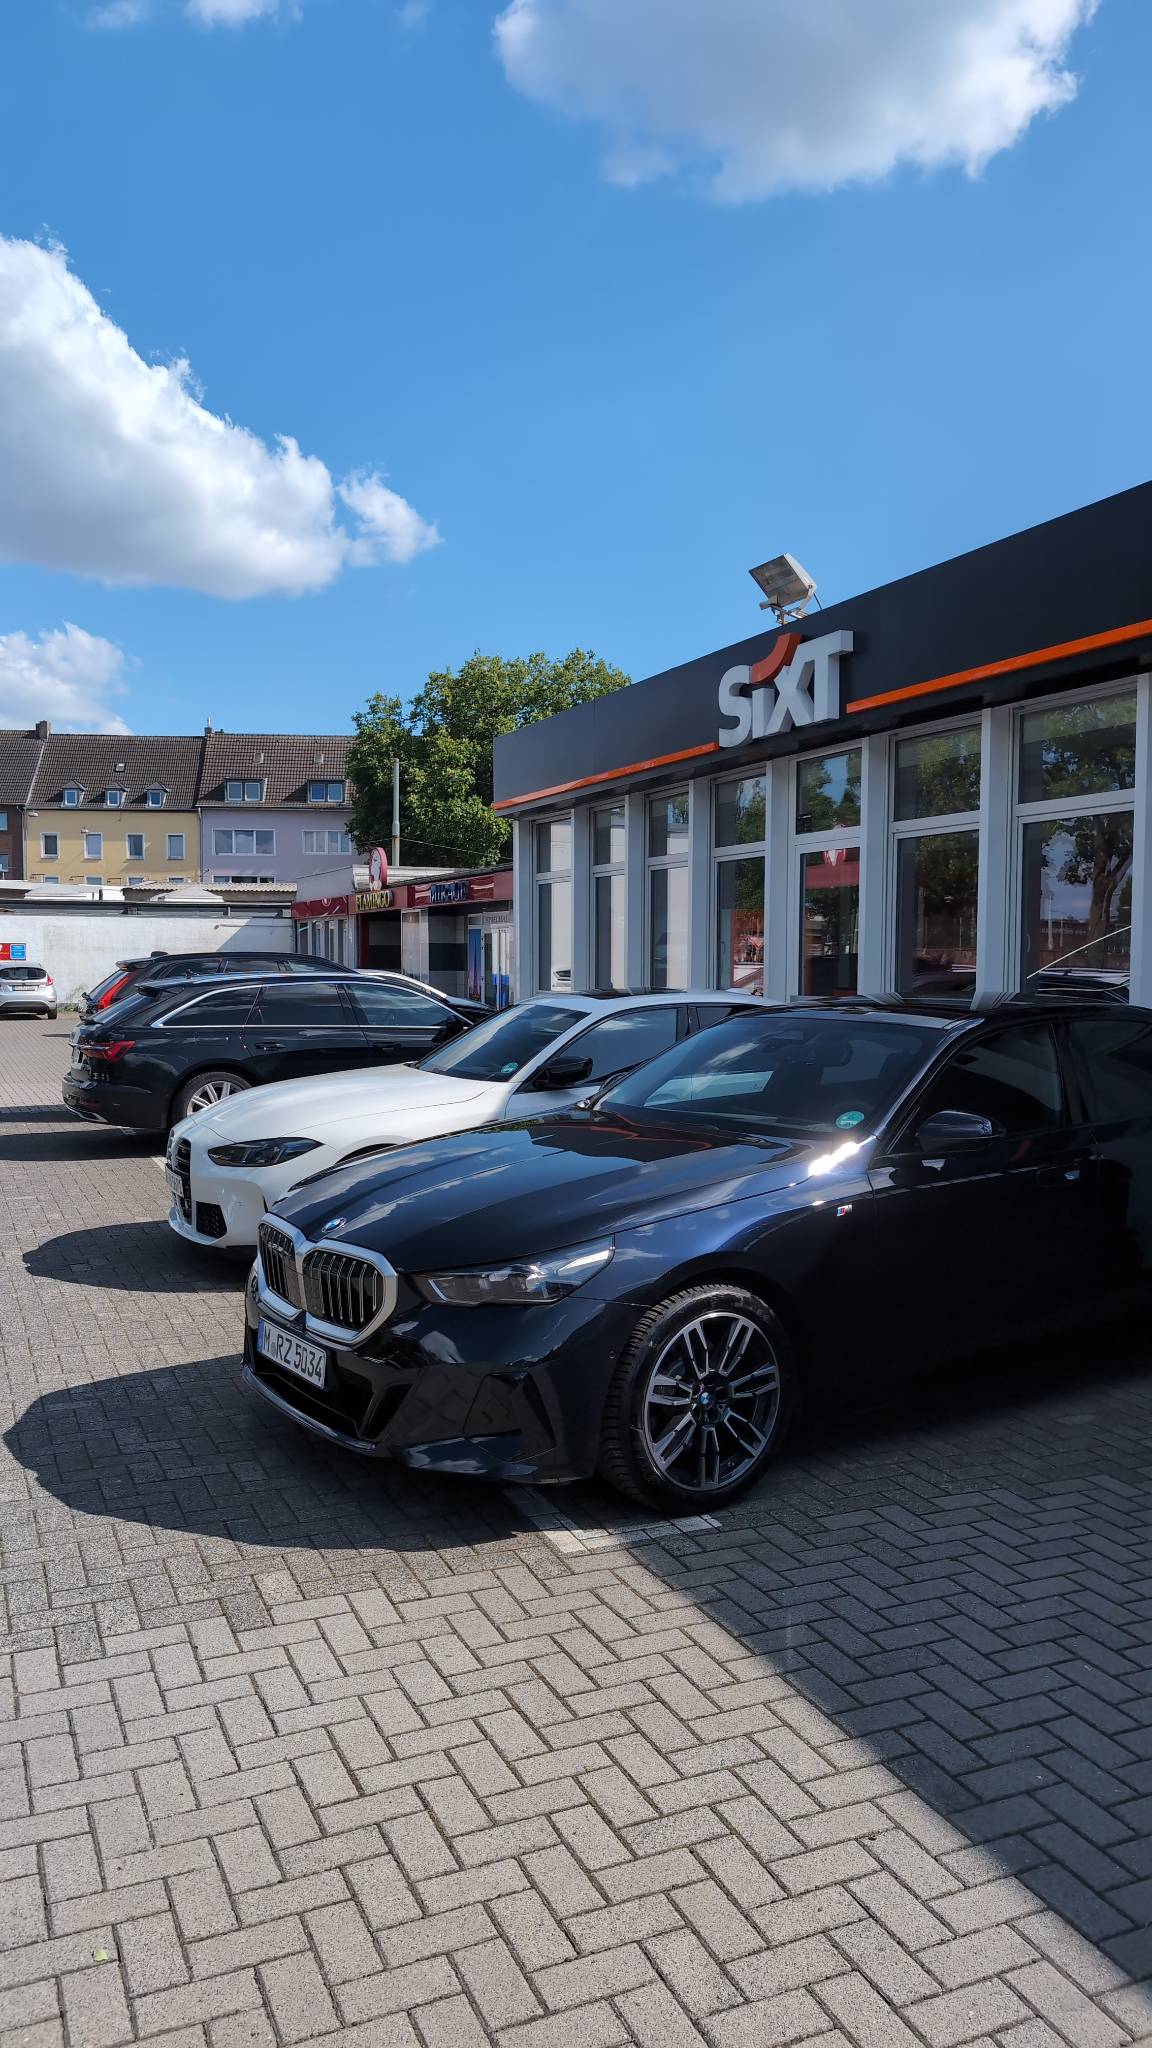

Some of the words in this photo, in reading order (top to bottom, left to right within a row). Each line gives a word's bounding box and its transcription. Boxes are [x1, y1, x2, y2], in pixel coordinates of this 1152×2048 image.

[718, 630, 854, 748] SIXT
[355, 890, 391, 911] FLAMINGO
[293, 1342, 322, 1381] 5034
